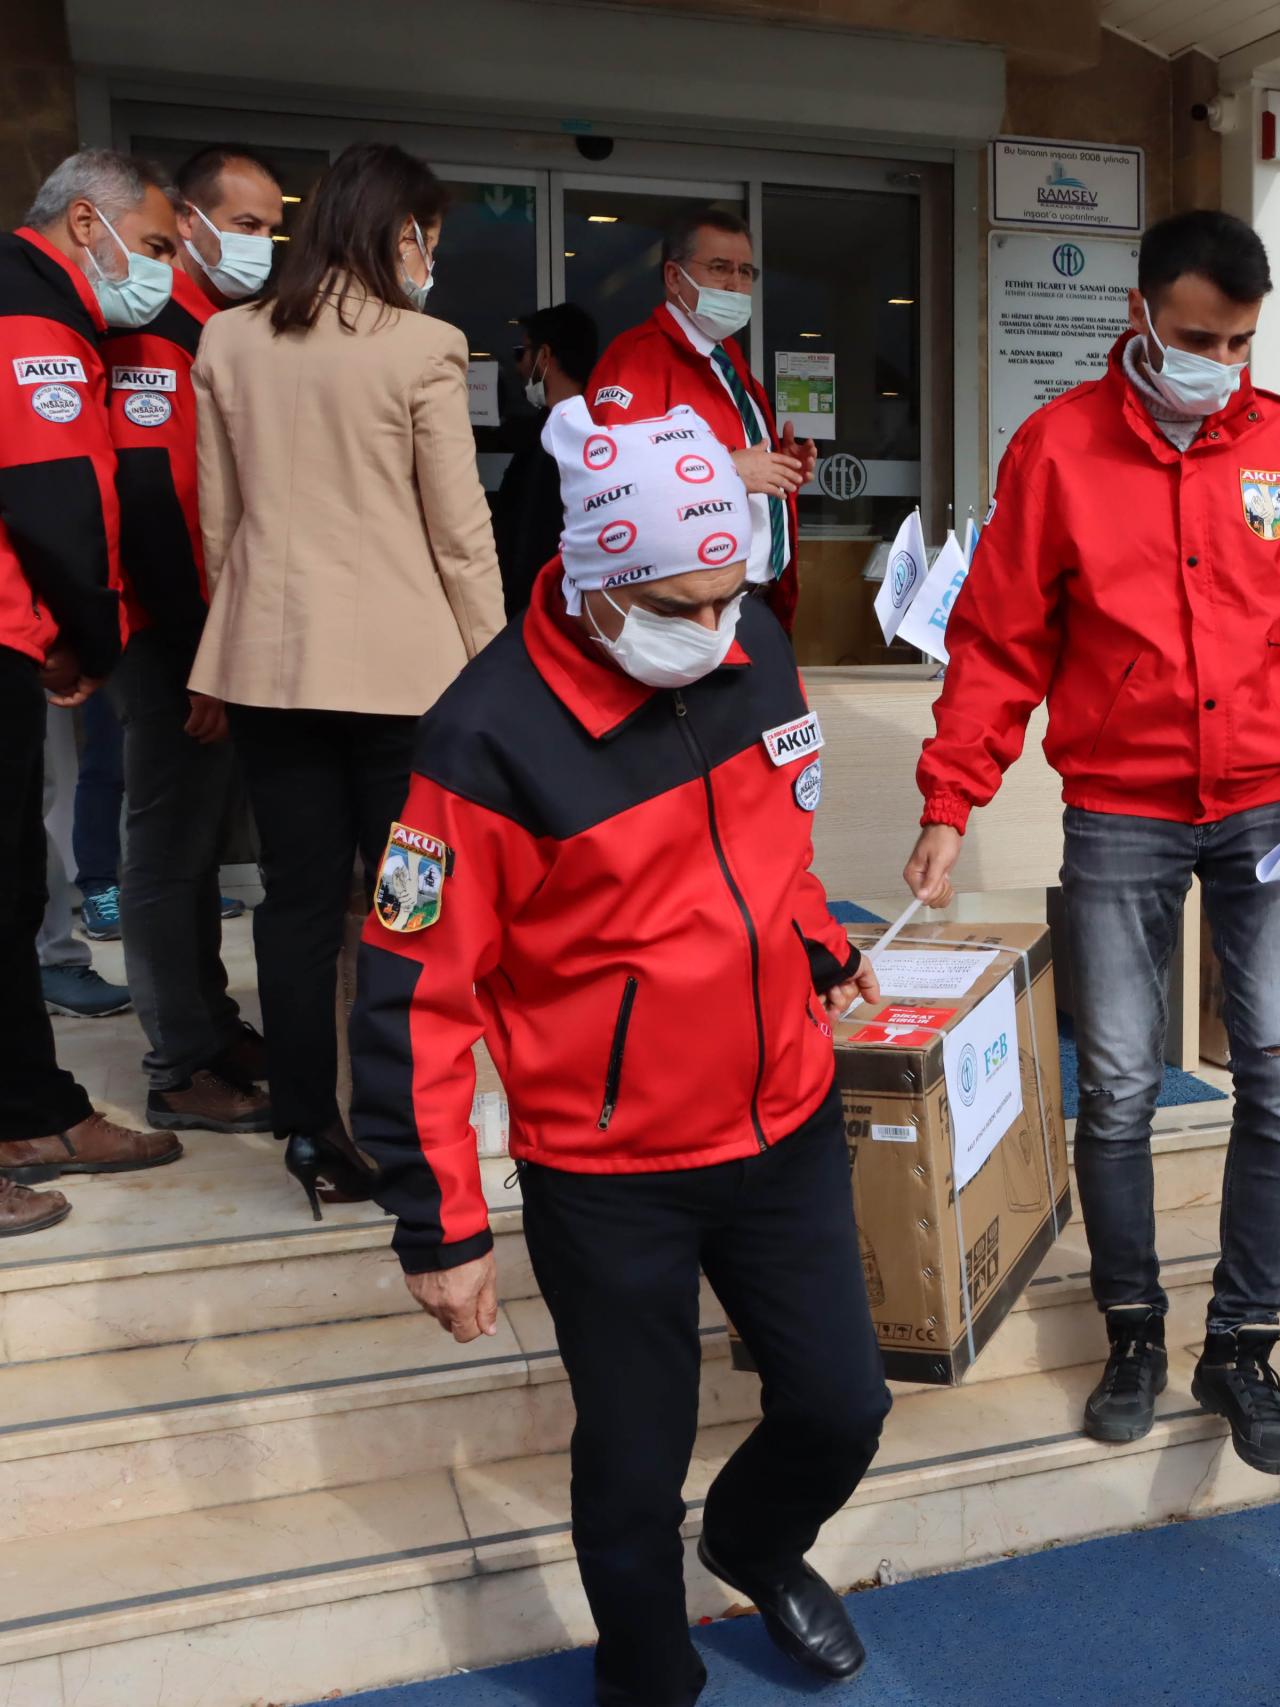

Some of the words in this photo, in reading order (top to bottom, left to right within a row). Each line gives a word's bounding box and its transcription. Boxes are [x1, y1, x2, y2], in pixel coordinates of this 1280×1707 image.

[1004, 146, 1015, 154] Bu
[1080, 152, 1100, 162] 2008
[1037, 187, 1099, 203] RAMSEV
[1005, 280, 1034, 289] FETHİYE
[1037, 281, 1066, 291] TİCARET
[1068, 283, 1077, 291] VE
[1080, 283, 1106, 292] SANAYİ
[25, 363, 77, 377] AKUT
[119, 372, 169, 385] AKUT
[599, 388, 627, 401] AKUT
[131, 406, 165, 414] INSARAG
[654, 429, 696, 444] AKUT
[589, 446, 609, 459] AKUT
[684, 464, 706, 473] AKUT
[585, 483, 634, 512] AKUT
[683, 501, 733, 520] AKUT
[605, 530, 628, 544] AKUT
[707, 543, 730, 553] AKUT
[604, 564, 654, 588] AKUT
[776, 723, 817, 755] AKUT
[393, 828, 443, 858] AKUT
